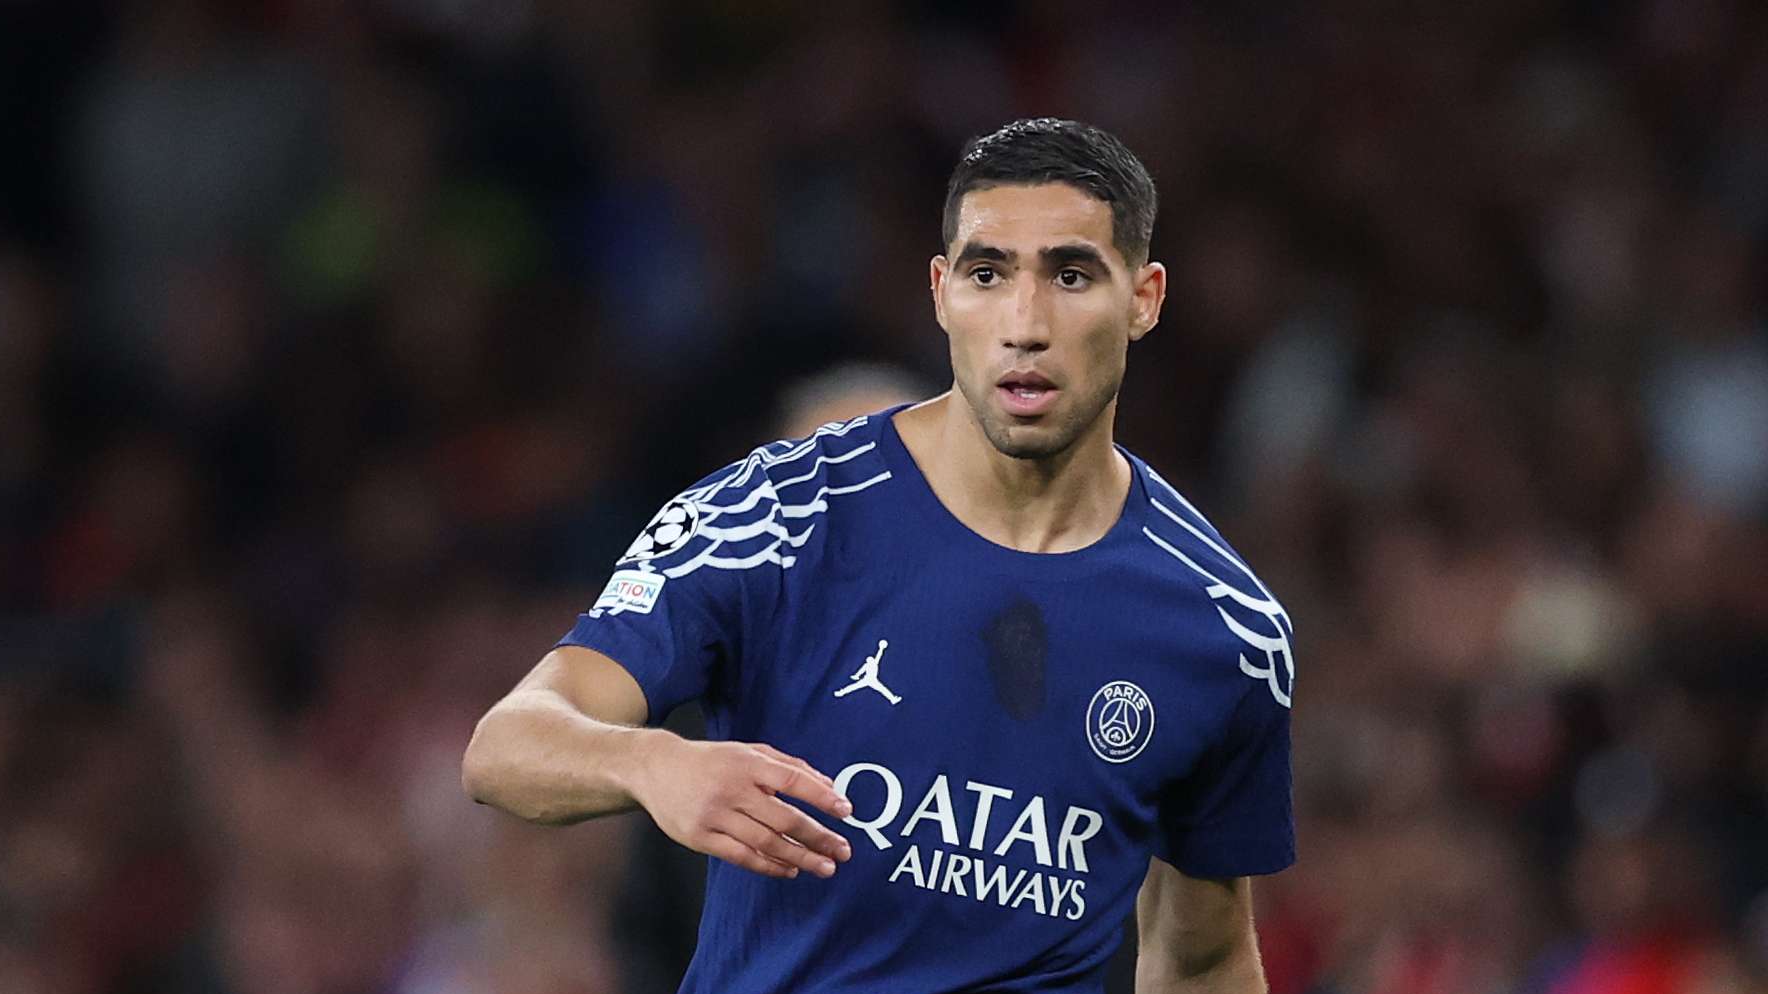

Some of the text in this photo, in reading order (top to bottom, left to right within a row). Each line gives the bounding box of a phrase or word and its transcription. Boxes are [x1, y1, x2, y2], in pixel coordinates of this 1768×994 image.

[609, 582, 656, 599] ATION
[1103, 685, 1148, 711] PARIS
[832, 762, 1103, 873] QATAR
[888, 845, 1085, 920] AIRWAYS
